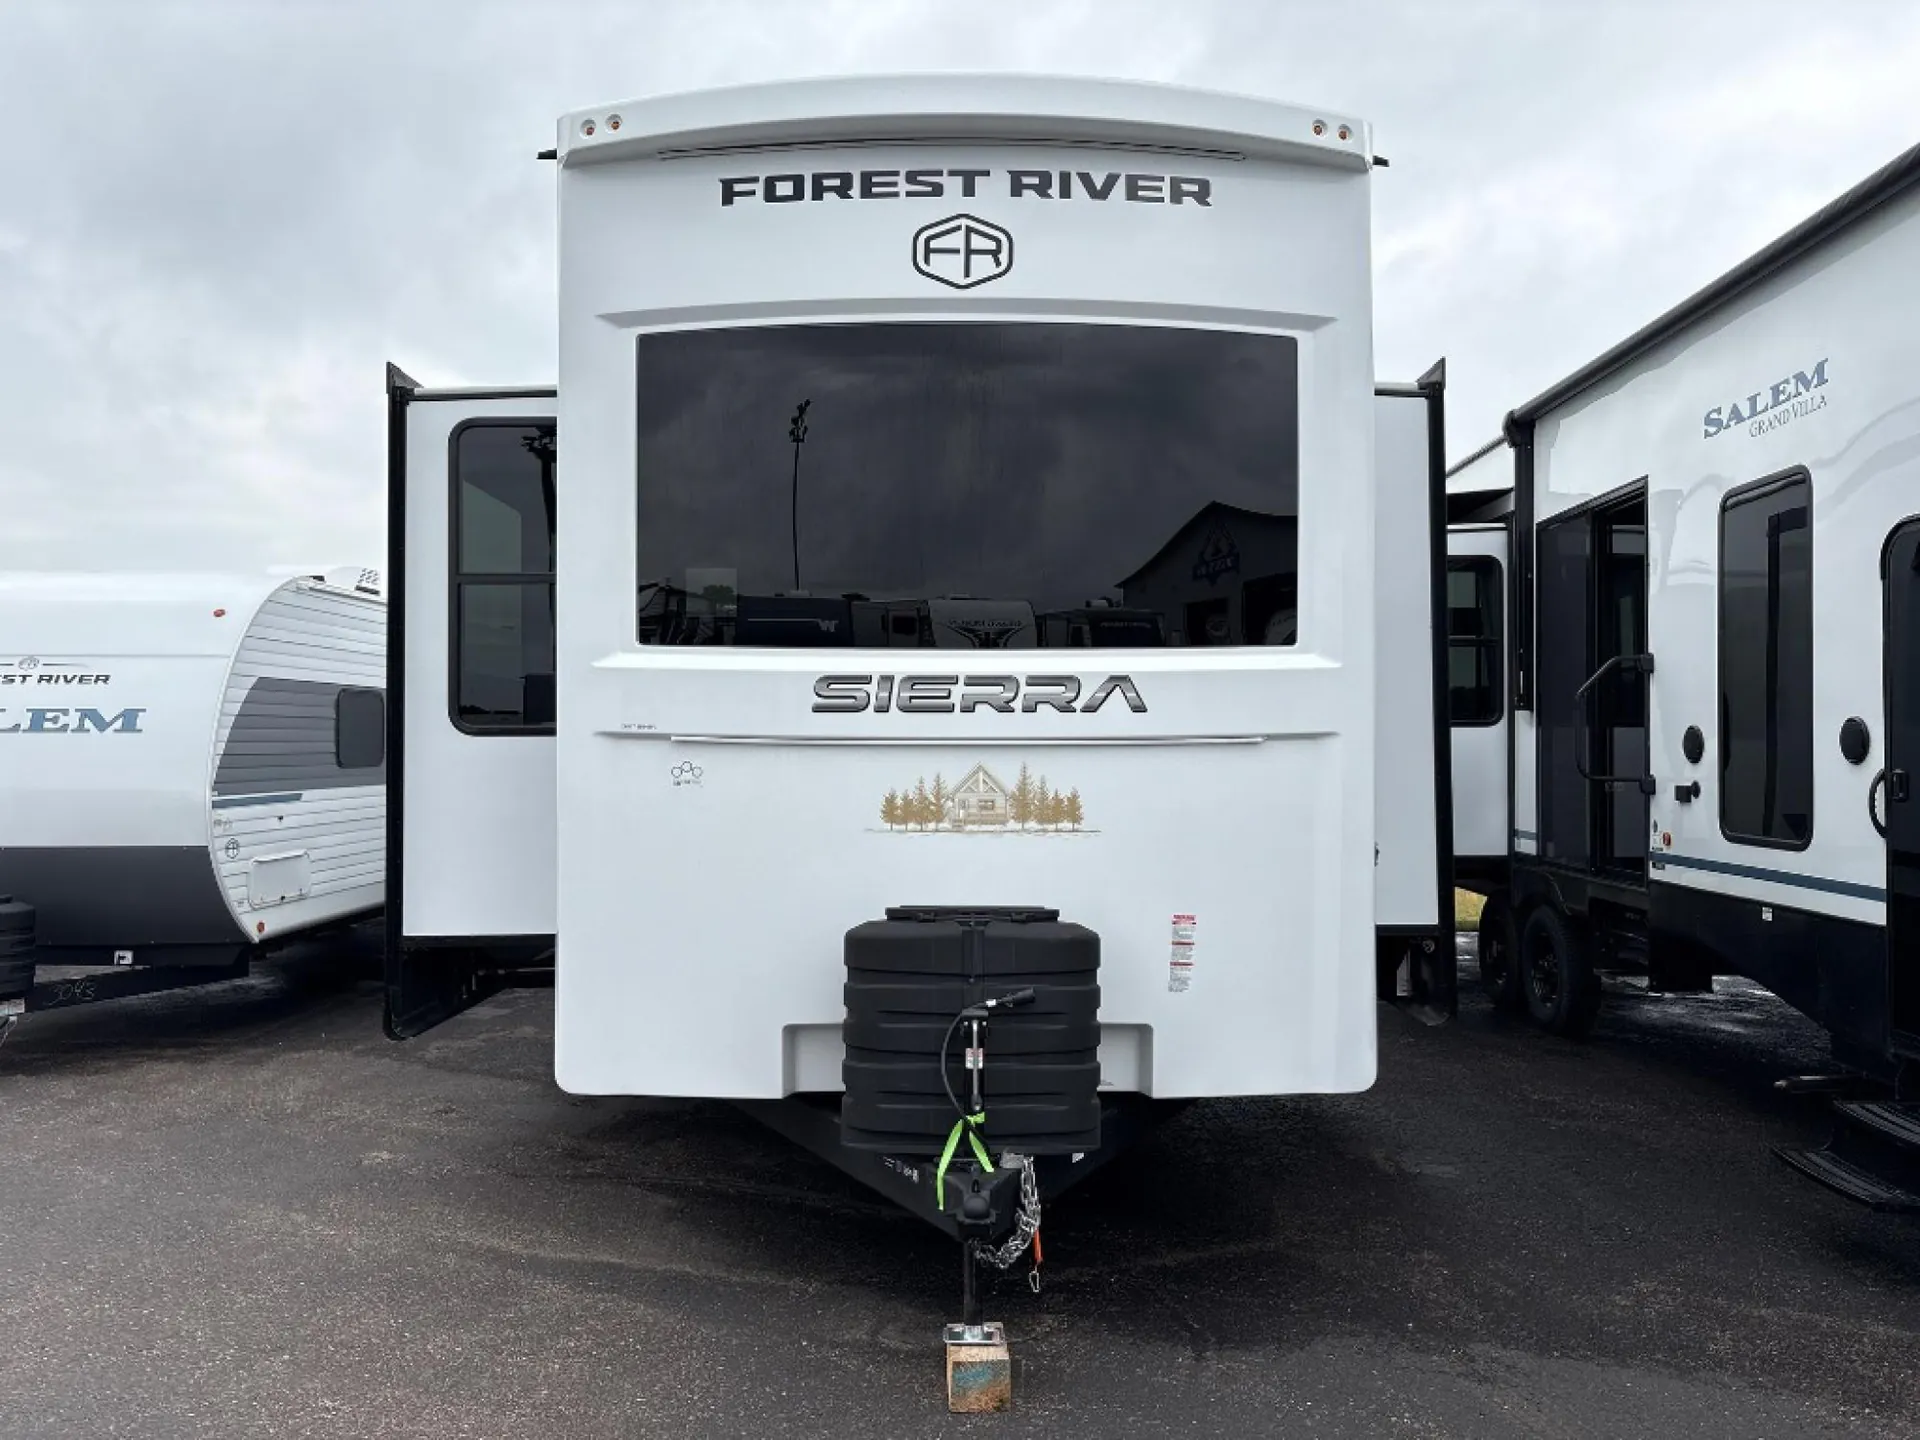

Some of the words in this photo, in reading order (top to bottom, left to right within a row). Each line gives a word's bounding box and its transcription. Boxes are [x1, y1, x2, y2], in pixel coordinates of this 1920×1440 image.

[718, 169, 991, 206] FOREST
[1007, 169, 1214, 207] RIVER
[924, 223, 1003, 279] FR
[1703, 357, 1829, 439] SALEM
[1748, 408, 1791, 438] GRAND
[1791, 394, 1828, 419] VILLA
[0, 674, 33, 685] ST
[37, 674, 111, 685] RIVER
[811, 674, 1148, 713] SIERRA
